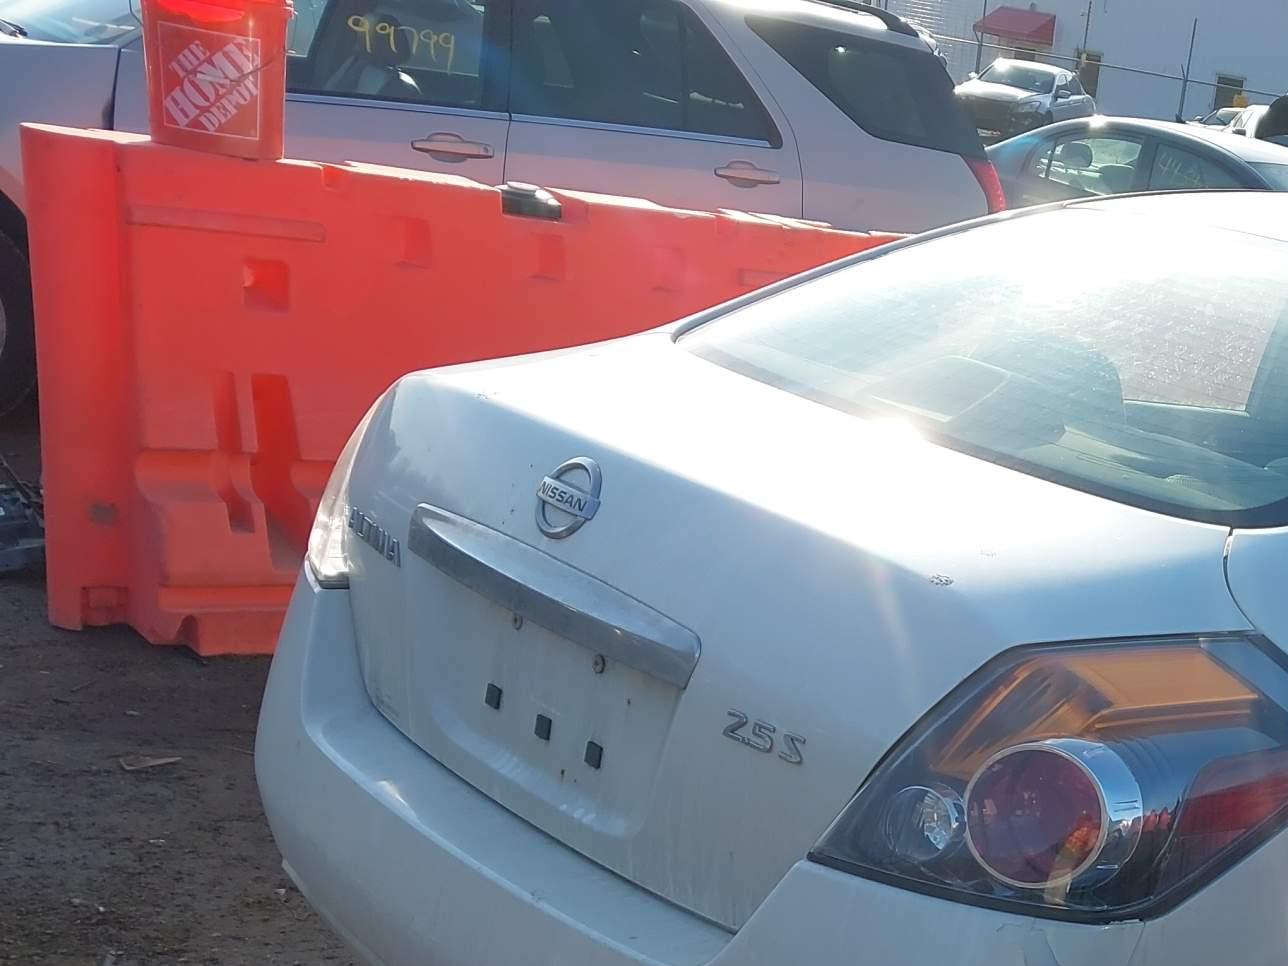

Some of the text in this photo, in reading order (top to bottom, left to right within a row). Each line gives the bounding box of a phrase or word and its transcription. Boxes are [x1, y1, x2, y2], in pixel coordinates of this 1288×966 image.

[169, 40, 210, 80] THE
[347, 15, 455, 75] 99799
[164, 39, 261, 128] HOME
[199, 75, 258, 132] DEPOT
[540, 480, 588, 513] NISSAN
[778, 731, 807, 765] S
